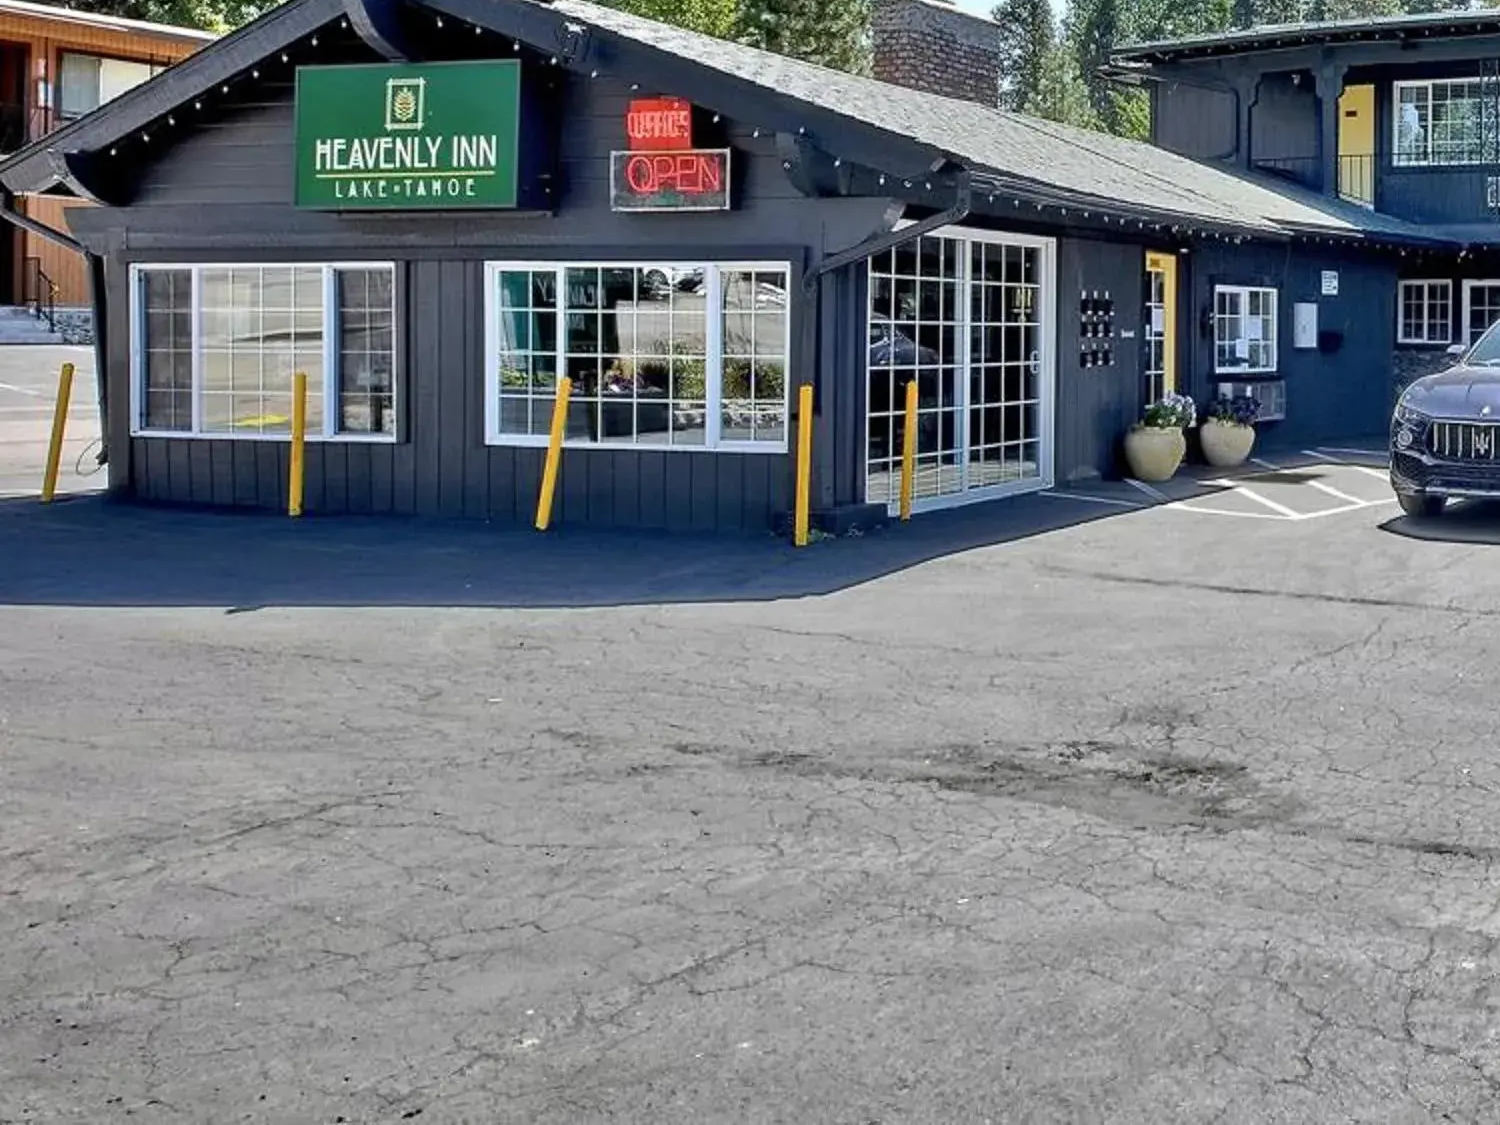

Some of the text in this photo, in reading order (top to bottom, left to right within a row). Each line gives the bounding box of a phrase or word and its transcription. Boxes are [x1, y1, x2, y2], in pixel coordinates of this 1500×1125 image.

[315, 134, 498, 170] HEAVENLY INN
[627, 156, 720, 192] OPEN
